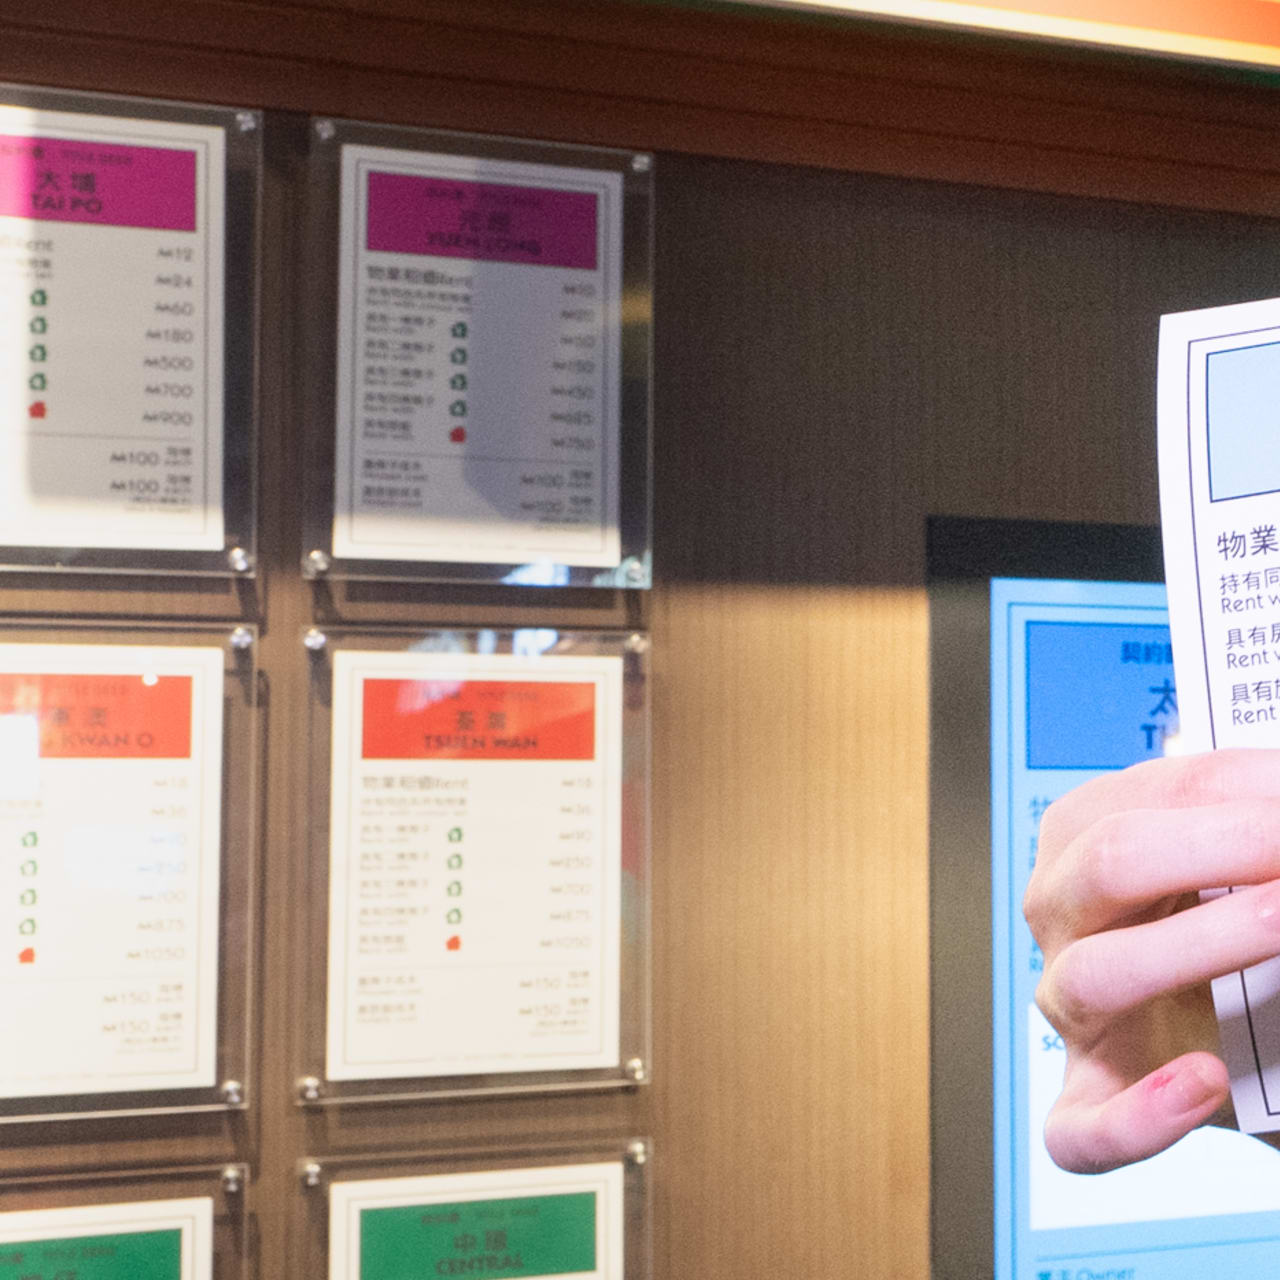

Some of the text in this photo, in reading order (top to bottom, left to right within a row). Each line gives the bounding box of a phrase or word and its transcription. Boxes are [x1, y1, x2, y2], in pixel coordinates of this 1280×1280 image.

[70, 197, 103, 215] PO
[1221, 595, 1264, 614] Rent
[1226, 650, 1269, 670] Rent
[1232, 706, 1277, 726] Rent
[136, 732, 155, 748] O
[435, 1253, 526, 1276] CENTRAL
